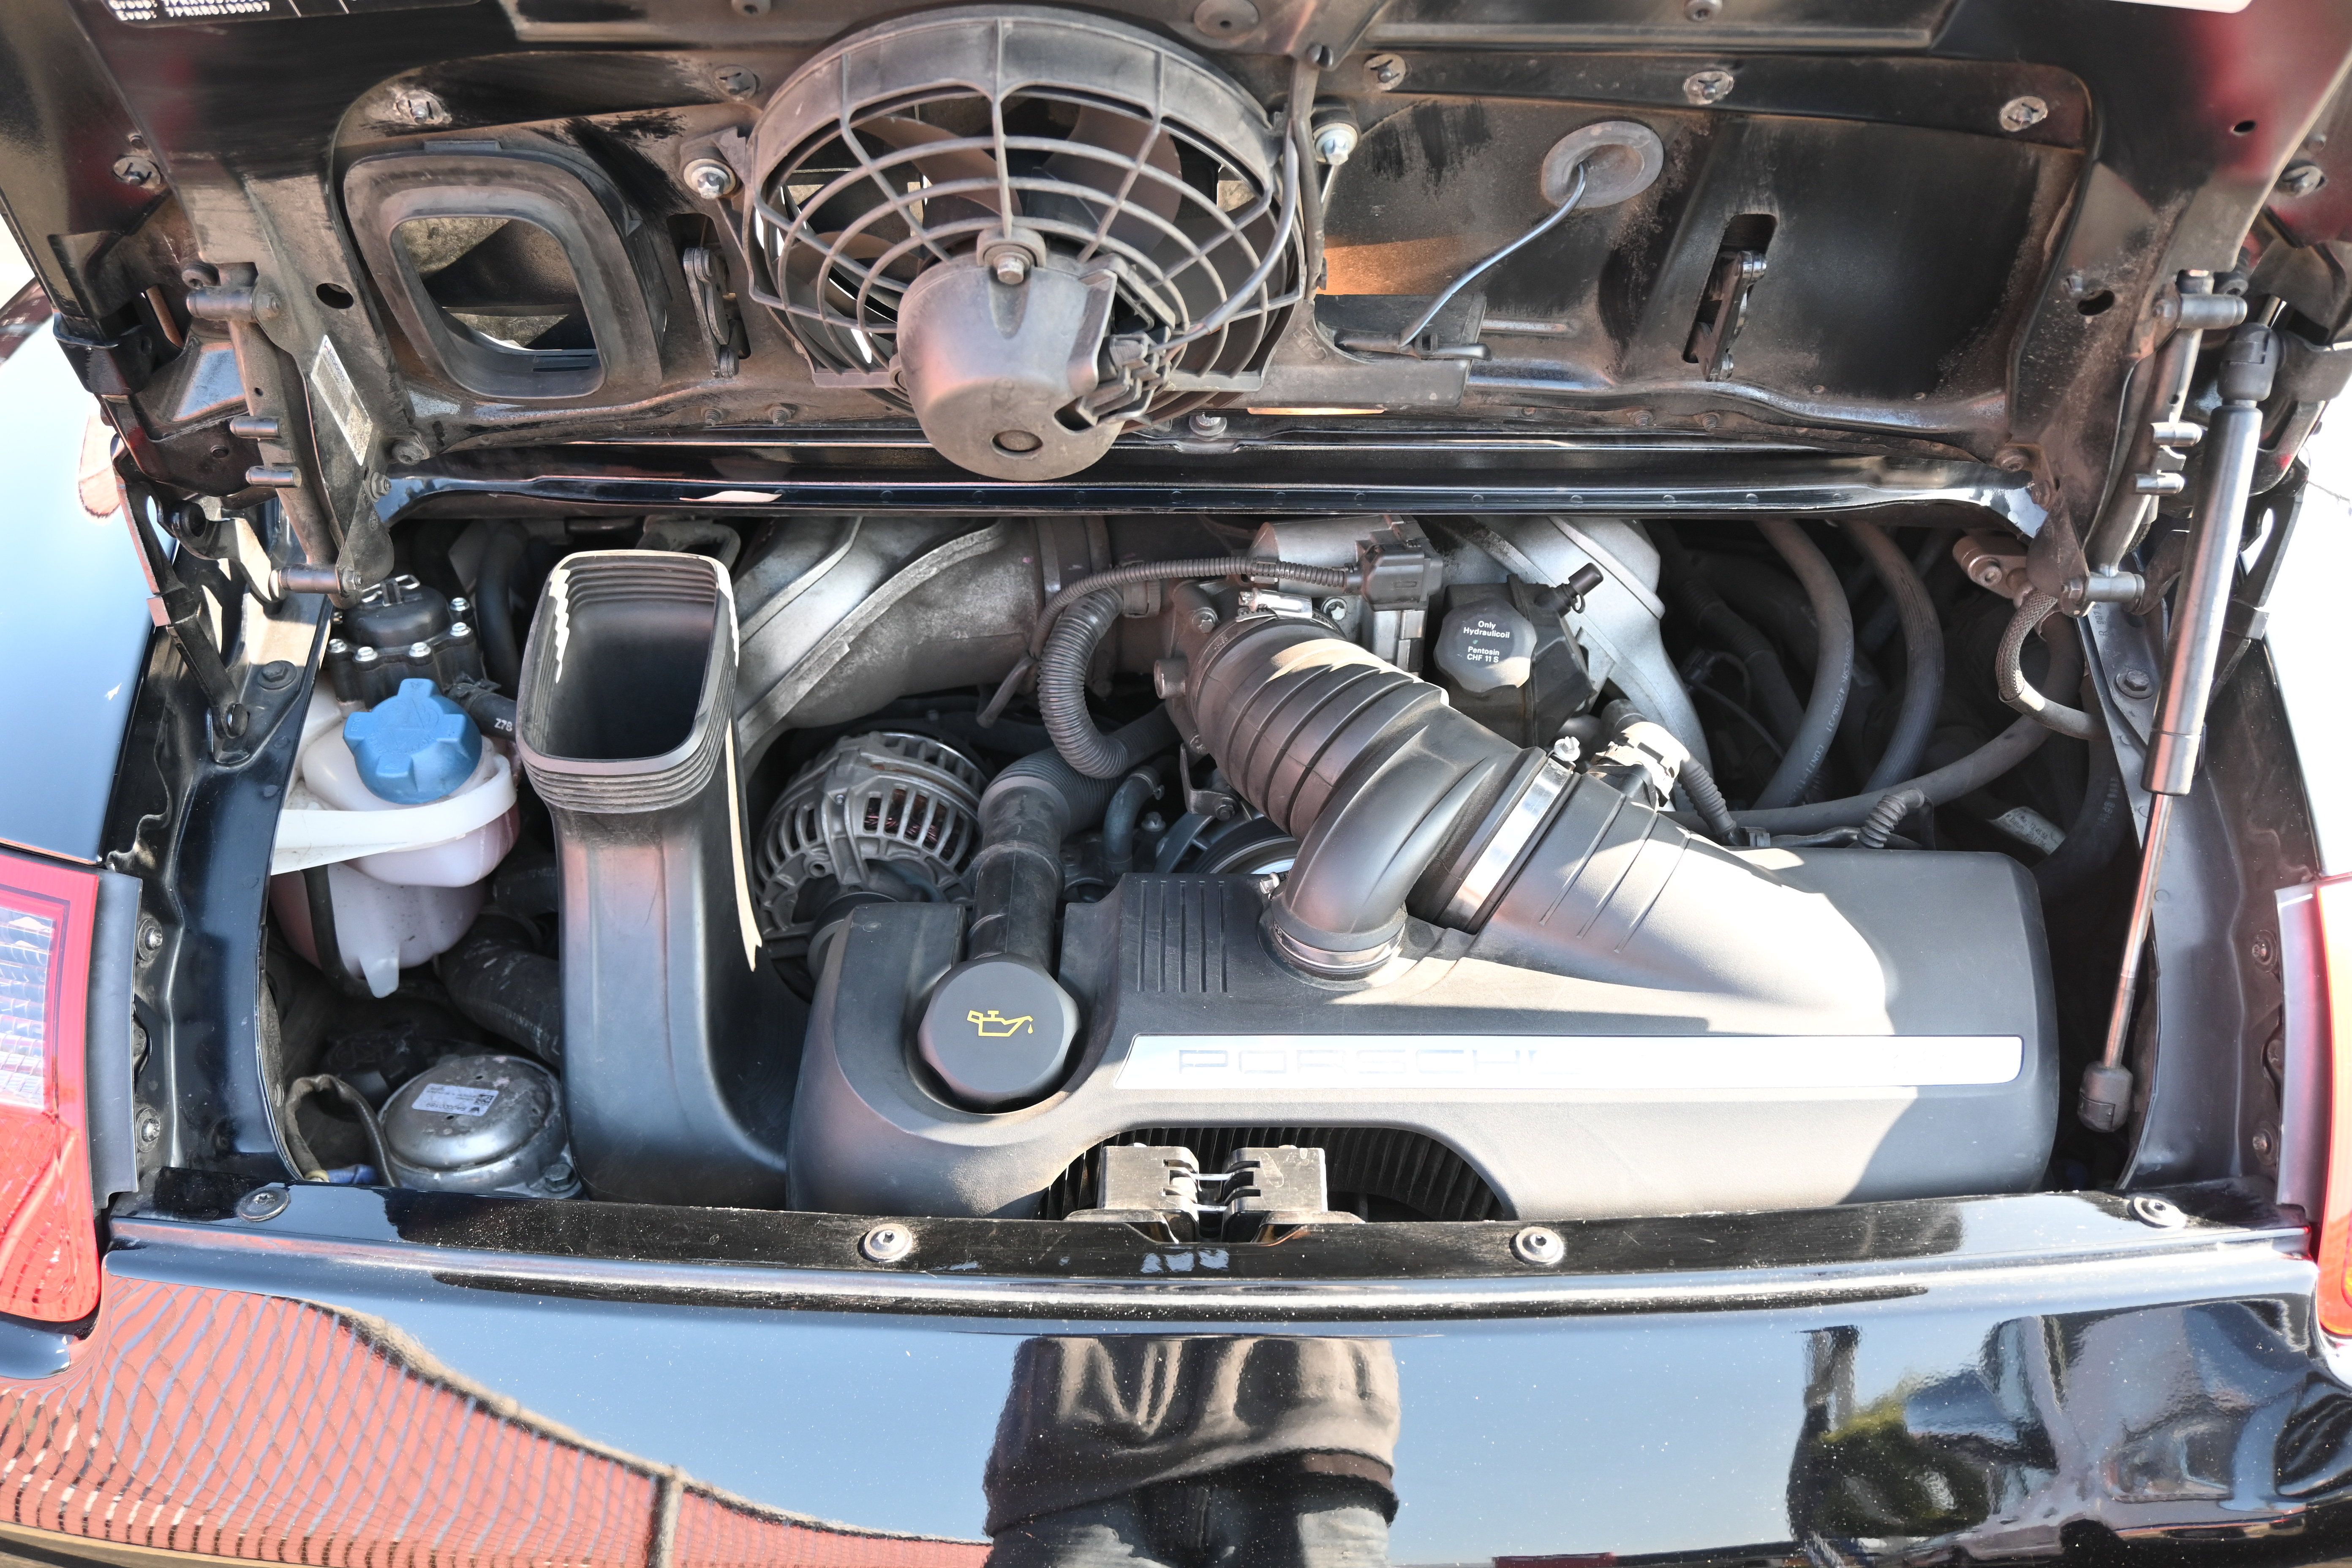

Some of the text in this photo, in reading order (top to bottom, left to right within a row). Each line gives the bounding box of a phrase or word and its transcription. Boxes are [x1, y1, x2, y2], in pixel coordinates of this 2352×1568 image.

[115, 9, 157, 21] Evap:
[324, 340, 345, 382] Webasto
[1478, 621, 1496, 630] Only
[1463, 626, 1510, 639] Hydraulicoil
[1467, 646, 1500, 656] Pentosin
[494, 718, 513, 732] Z78
